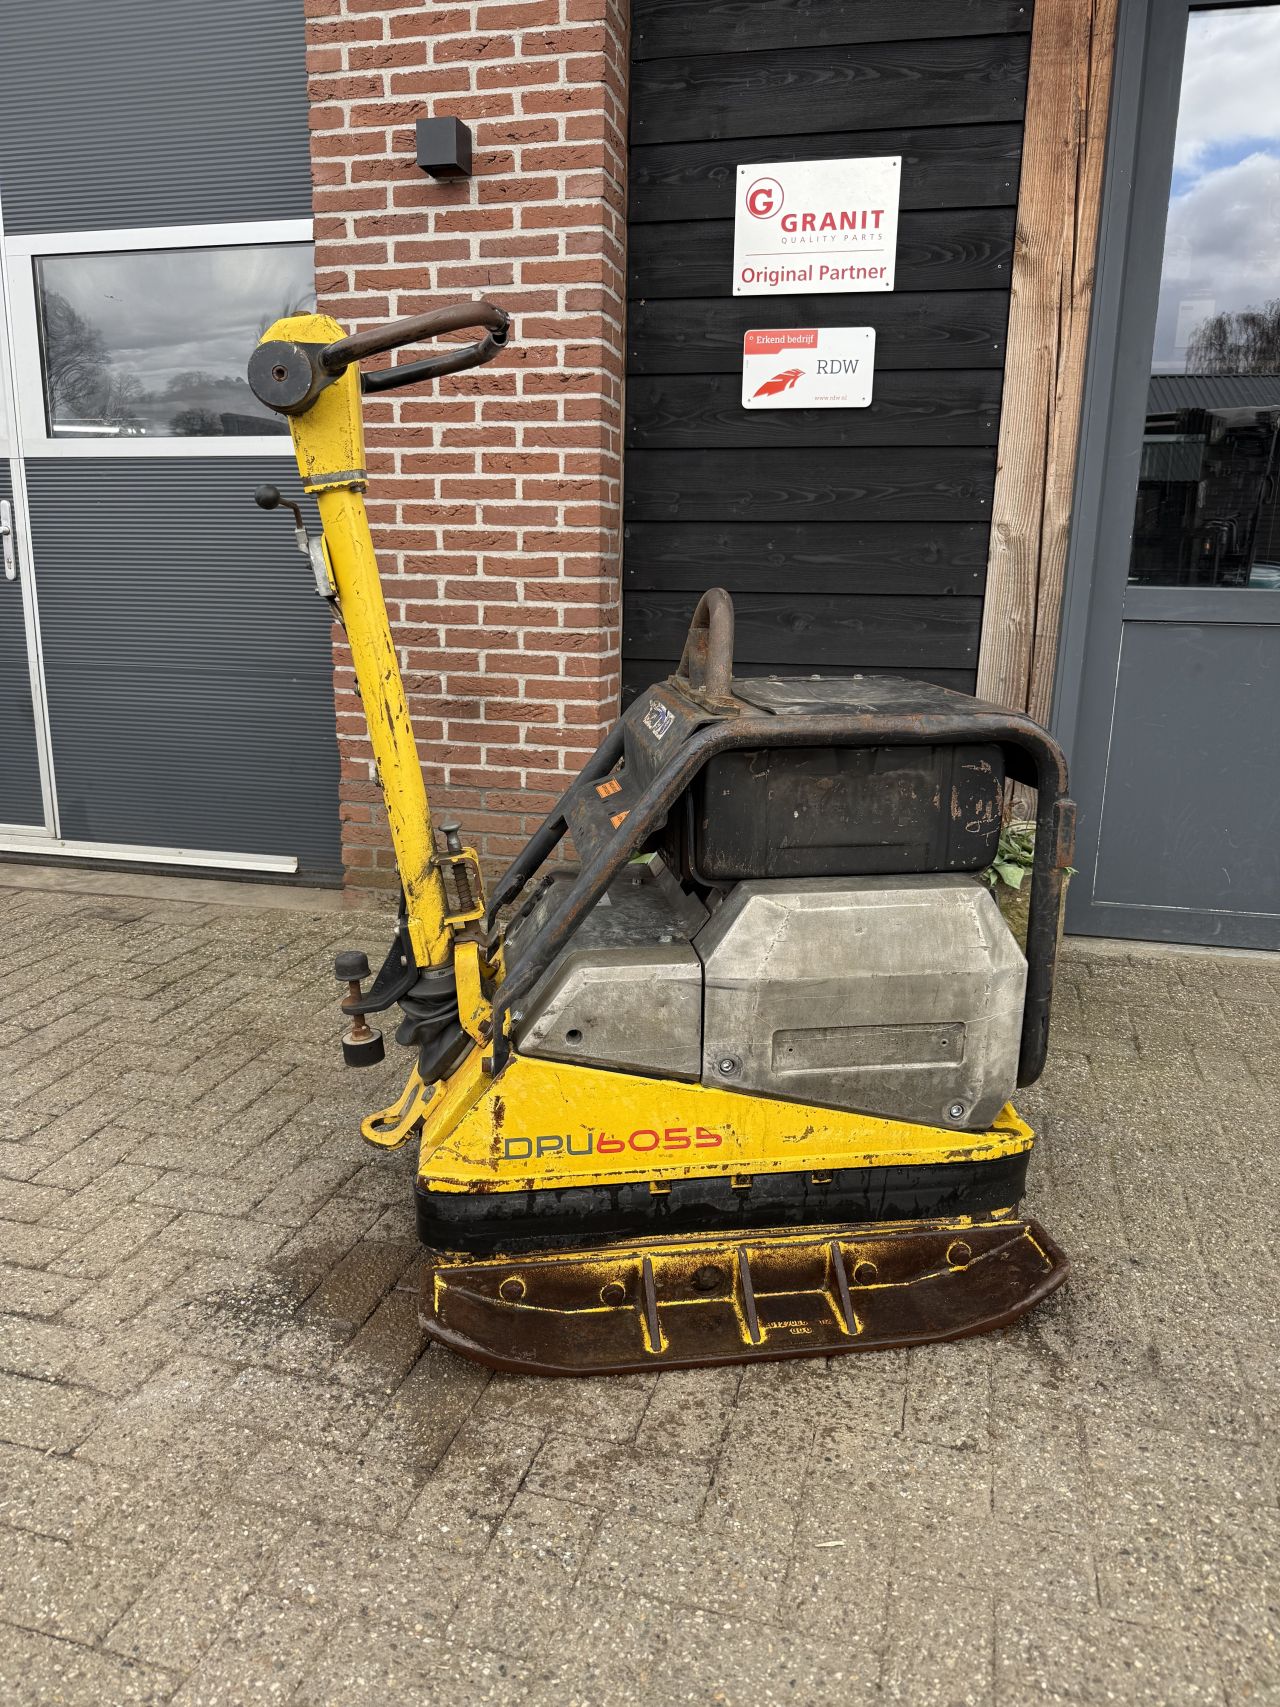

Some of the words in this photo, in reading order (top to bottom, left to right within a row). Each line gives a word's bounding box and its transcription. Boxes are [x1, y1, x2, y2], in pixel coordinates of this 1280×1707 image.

[780, 210, 884, 232] GRANIT
[781, 235, 836, 245] QUALITY
[843, 233, 883, 241] PARTS
[741, 265, 813, 286] Original
[819, 265, 887, 280] Partner
[756, 335, 785, 344] Erkend
[787, 334, 814, 345] bedrijf
[816, 359, 859, 375] RDW
[504, 1127, 723, 1160] DPU6055
